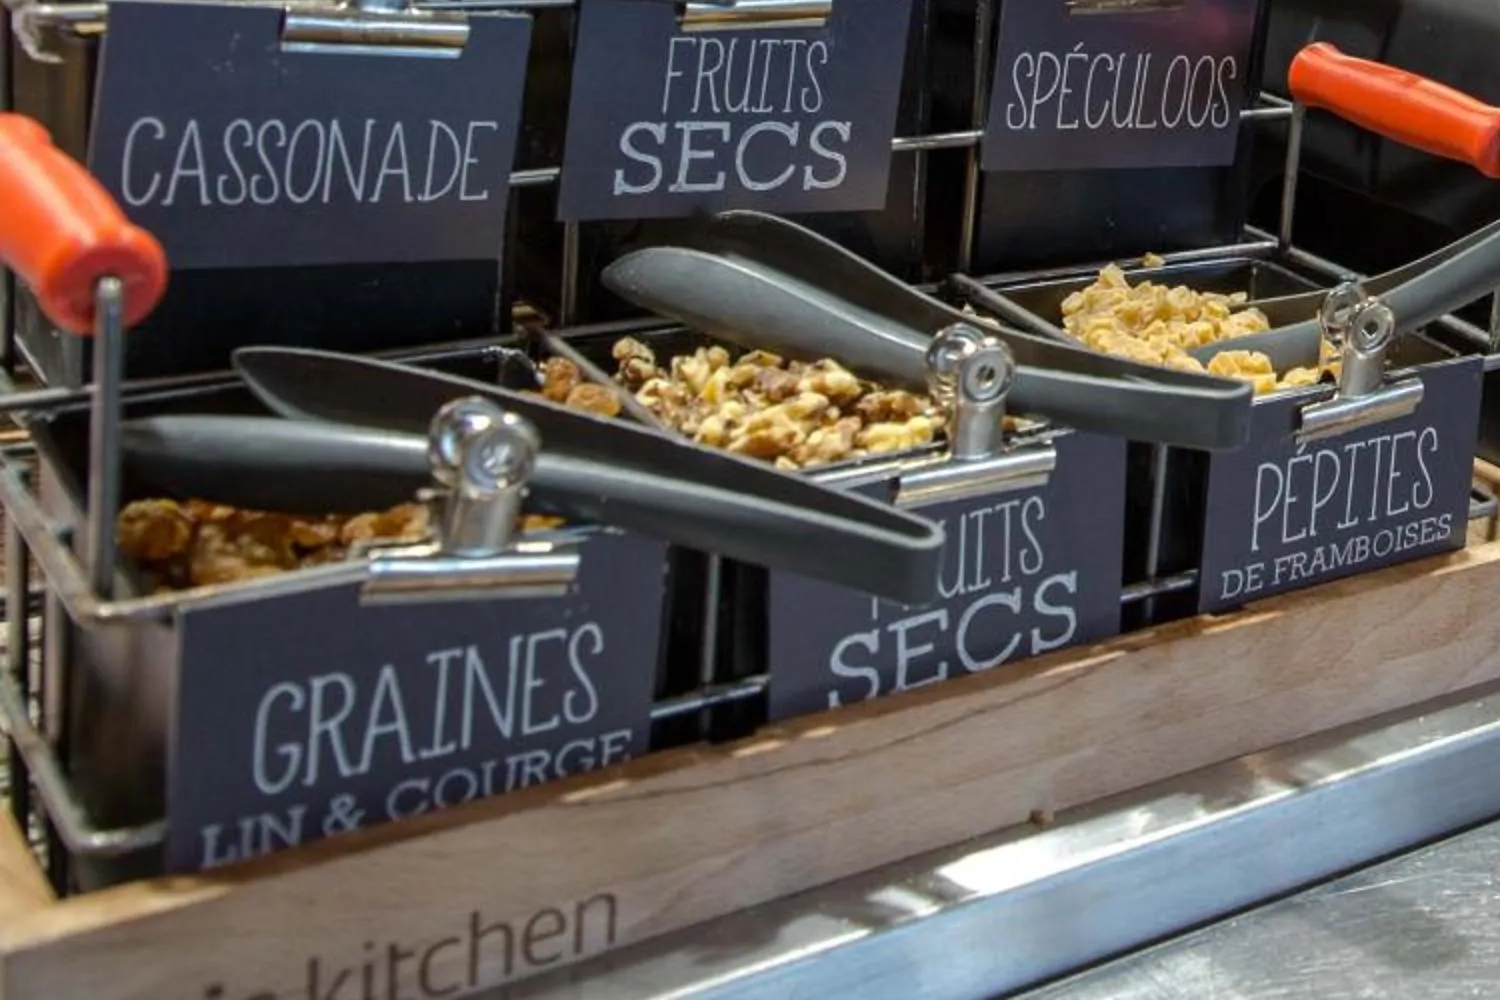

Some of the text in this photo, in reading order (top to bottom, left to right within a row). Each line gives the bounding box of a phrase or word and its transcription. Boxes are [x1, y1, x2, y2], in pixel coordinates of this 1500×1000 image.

[661, 36, 829, 115] FRUITS
[1005, 41, 1238, 130] SPÉCULOOS
[121, 116, 498, 207] CASSONADE
[612, 120, 853, 196] SECS
[1250, 426, 1439, 552] PÉPITES
[1220, 512, 1454, 600] DE FRAMBOISES
[827, 569, 1078, 709] SECS
[252, 621, 605, 796] GRAINES
[202, 729, 634, 871] LIN & COURGE
